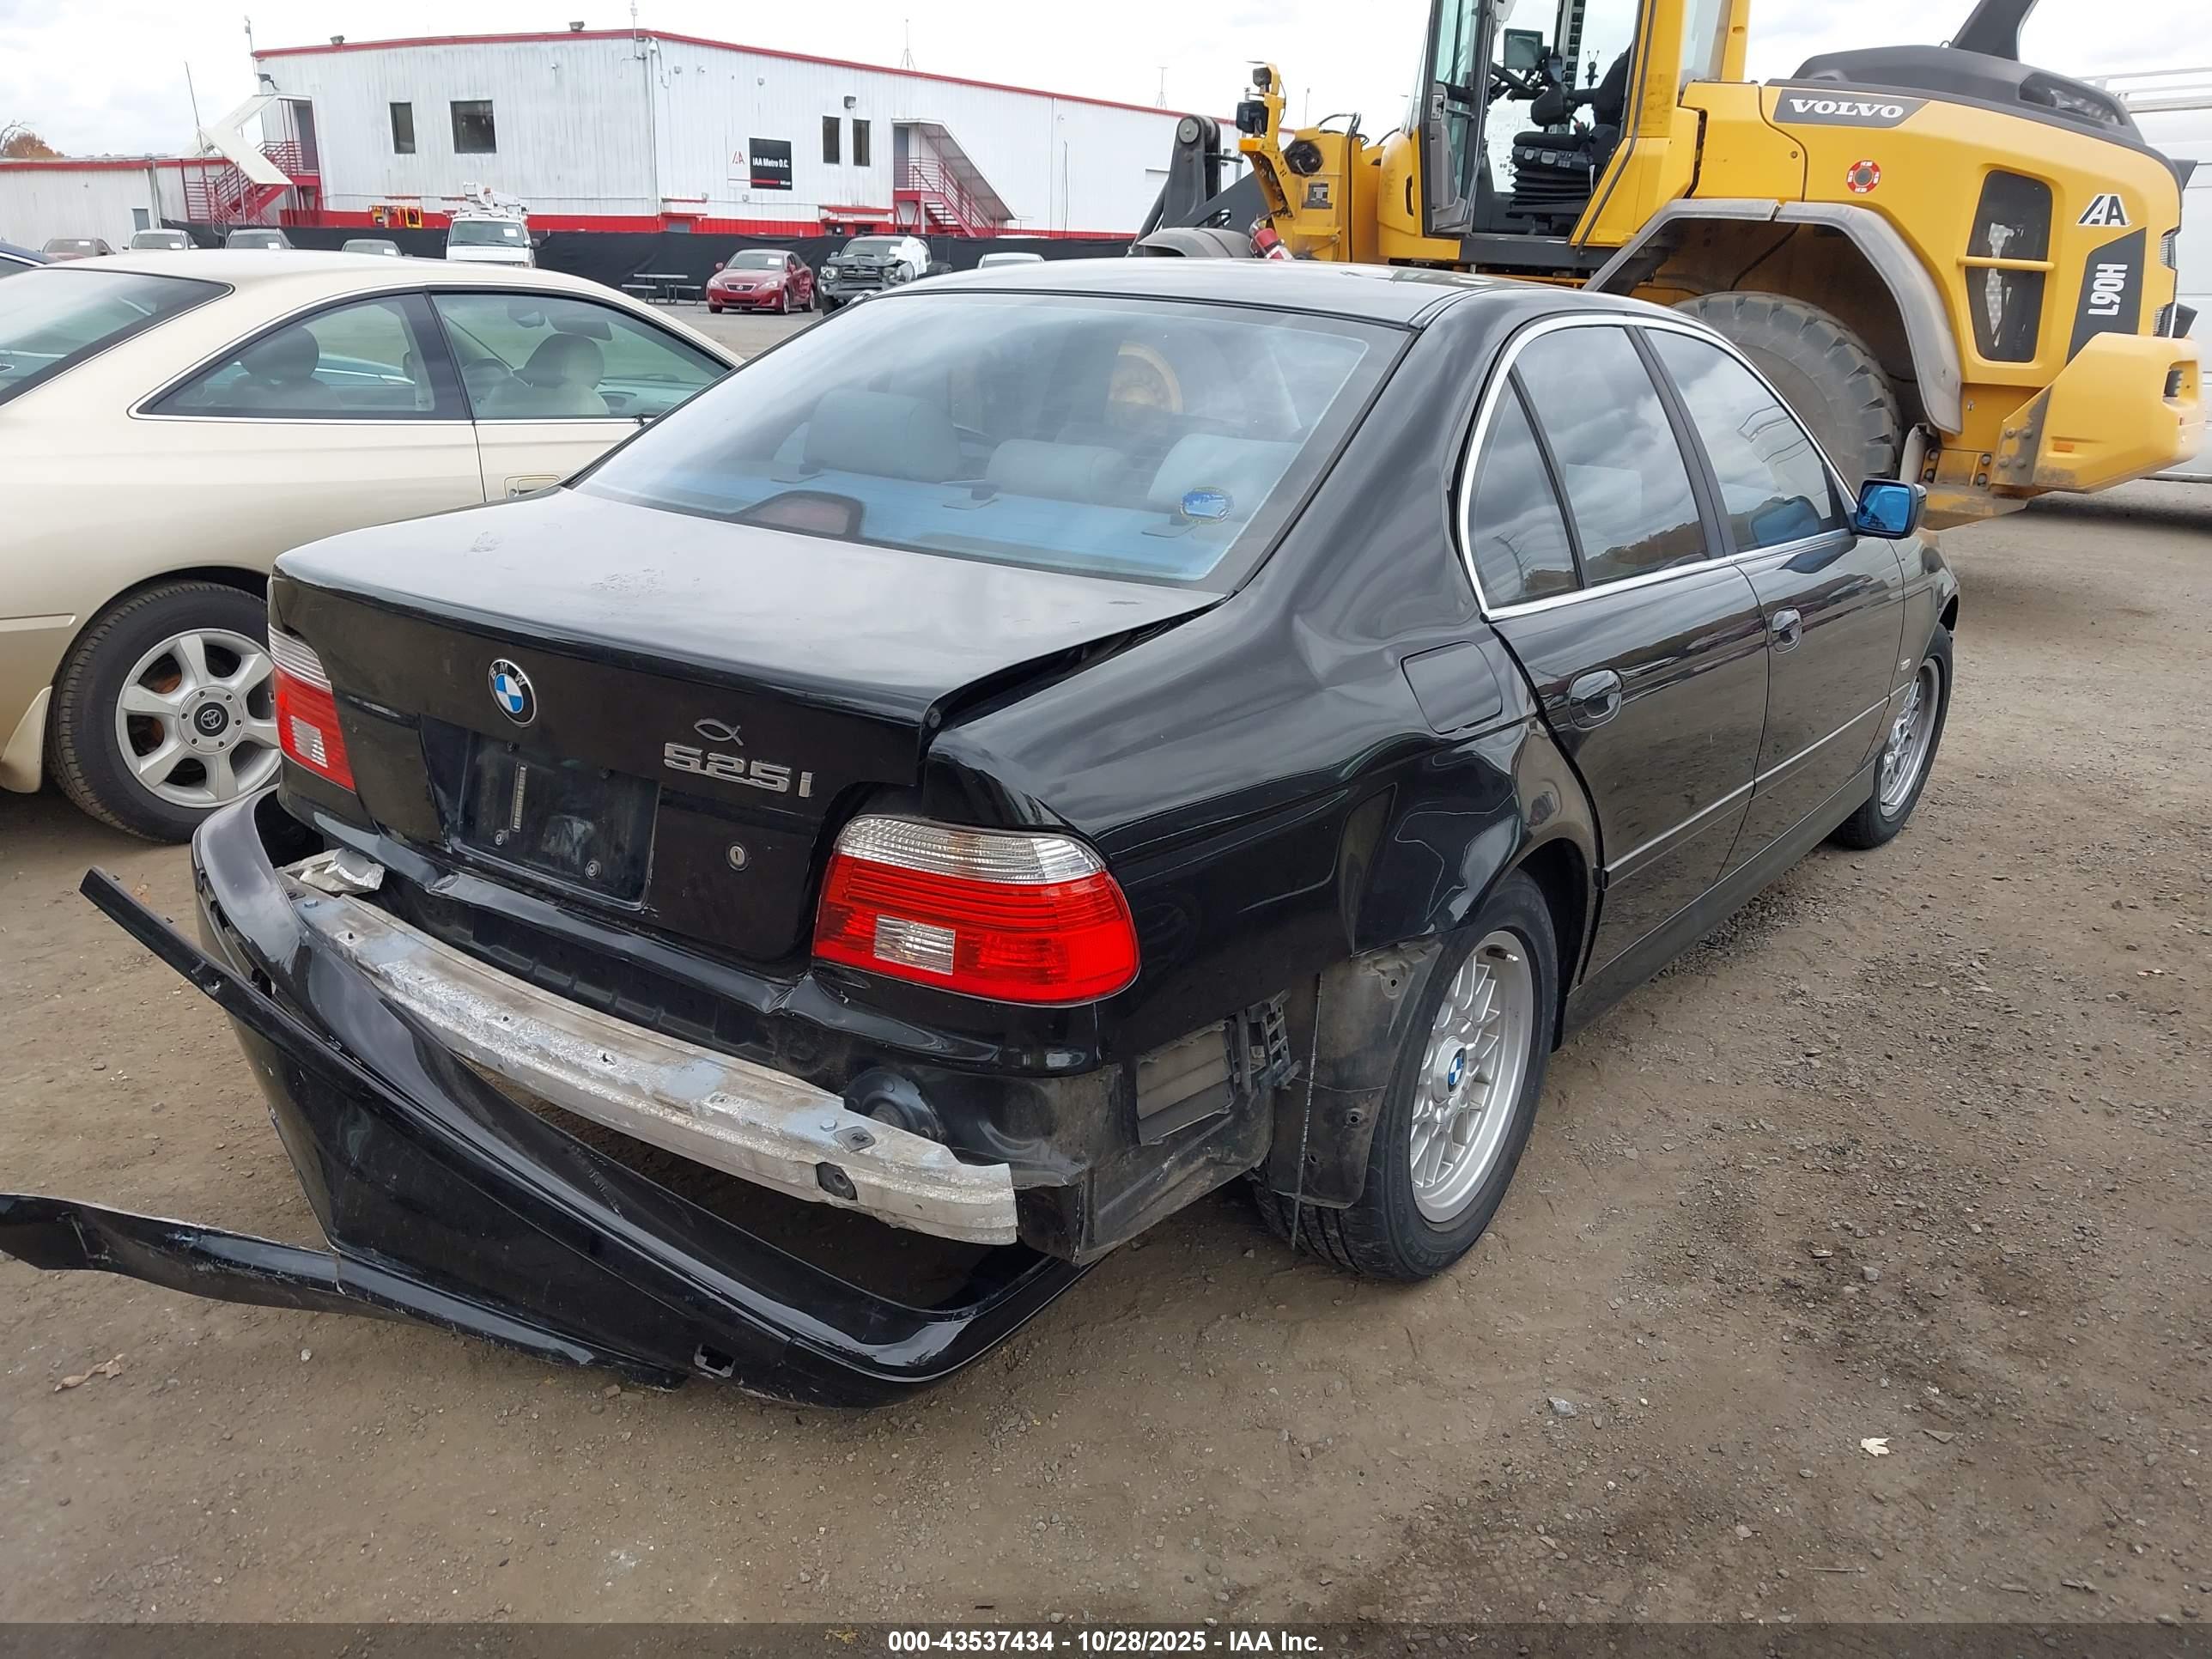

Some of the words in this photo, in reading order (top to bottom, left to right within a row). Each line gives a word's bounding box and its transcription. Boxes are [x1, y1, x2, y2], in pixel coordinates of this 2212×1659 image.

[1789, 99, 1904, 118] VOLVO
[752, 156, 763, 167] IAA
[763, 157, 779, 168] Metro
[2087, 263, 2128, 316] L90H
[489, 661, 527, 688] BMW
[664, 742, 814, 798] 525i
